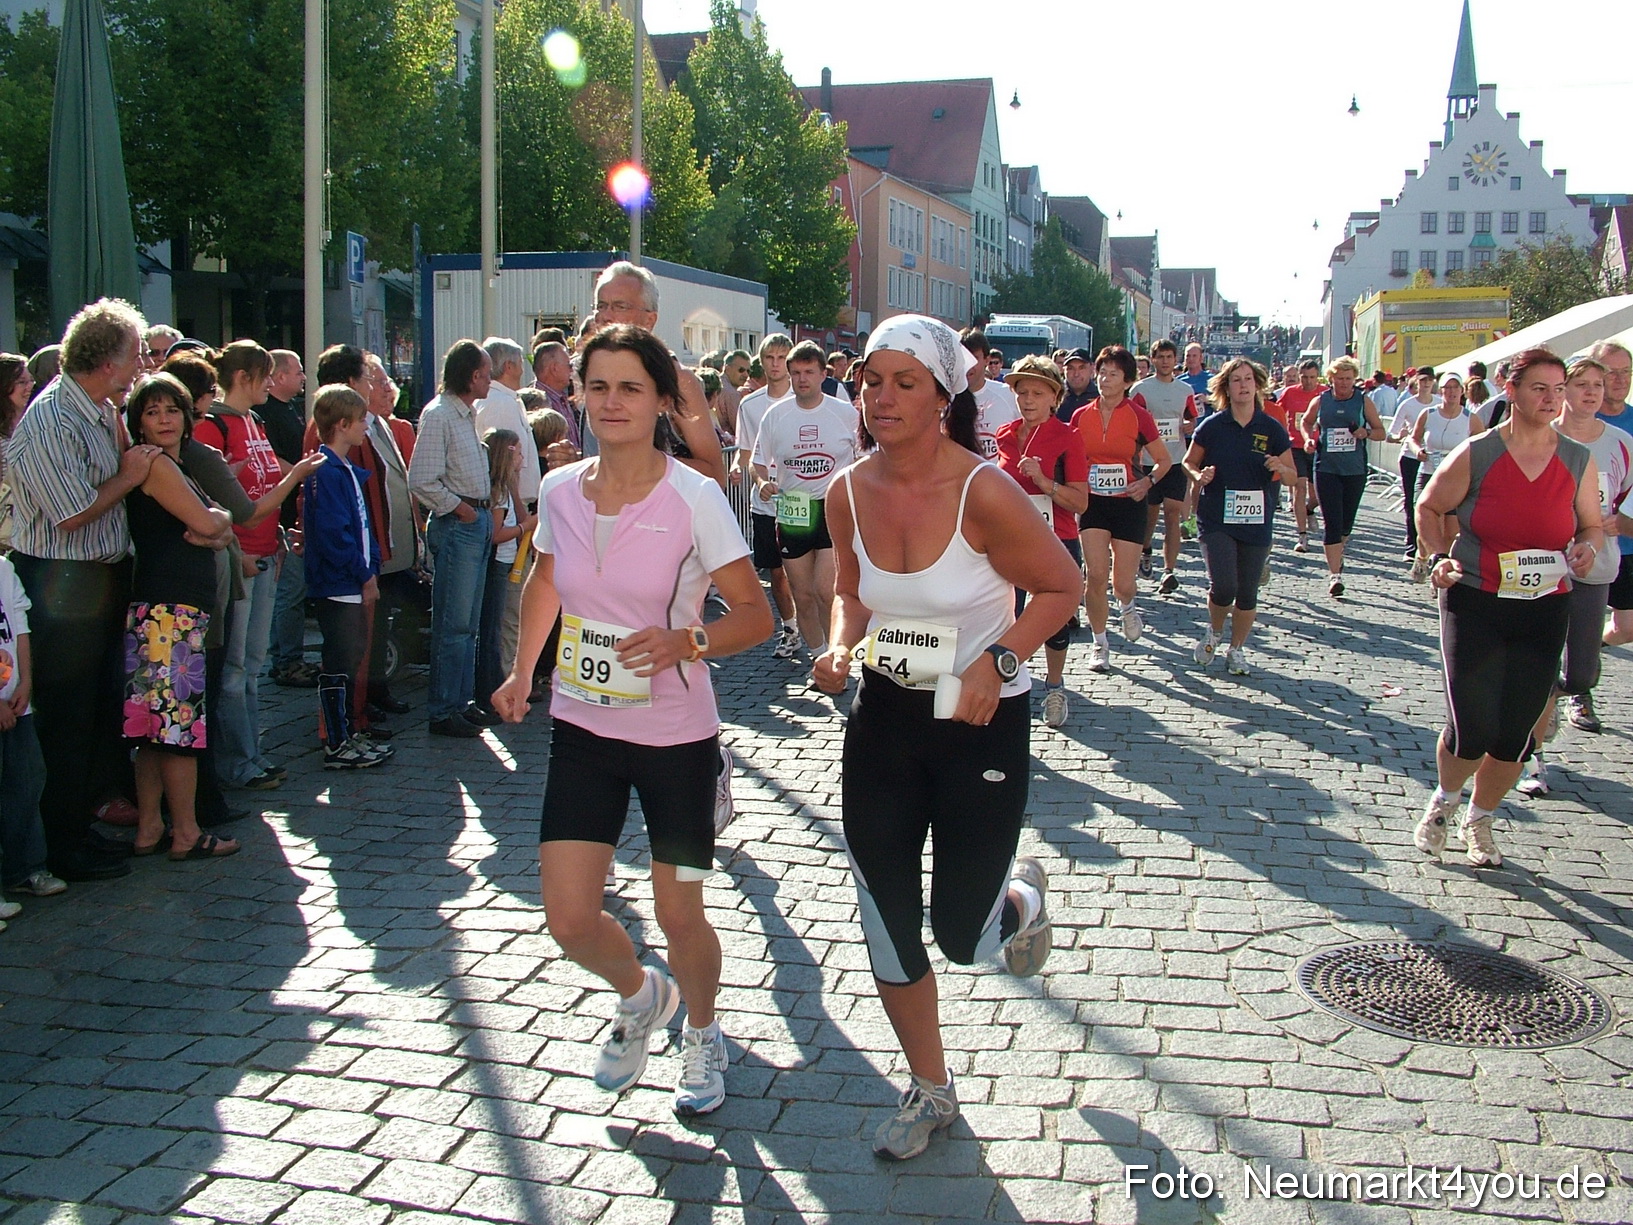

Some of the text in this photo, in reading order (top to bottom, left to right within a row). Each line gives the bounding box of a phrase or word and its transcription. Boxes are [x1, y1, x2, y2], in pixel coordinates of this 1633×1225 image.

[351, 239, 361, 275] P
[1460, 321, 1491, 332] Müller
[1334, 438, 1355, 446] 2346
[783, 459, 825, 467] GERHART
[1098, 477, 1125, 487] 2410
[784, 505, 808, 517] 2013
[1236, 505, 1262, 515] 2703
[1517, 556, 1556, 566] Johanna
[1506, 571, 1514, 580] C
[1520, 573, 1542, 587] 53
[877, 628, 939, 648] Gabriele
[562, 646, 572, 660] C
[855, 647, 866, 660] C
[581, 656, 611, 684] 99
[878, 655, 911, 679] 54
